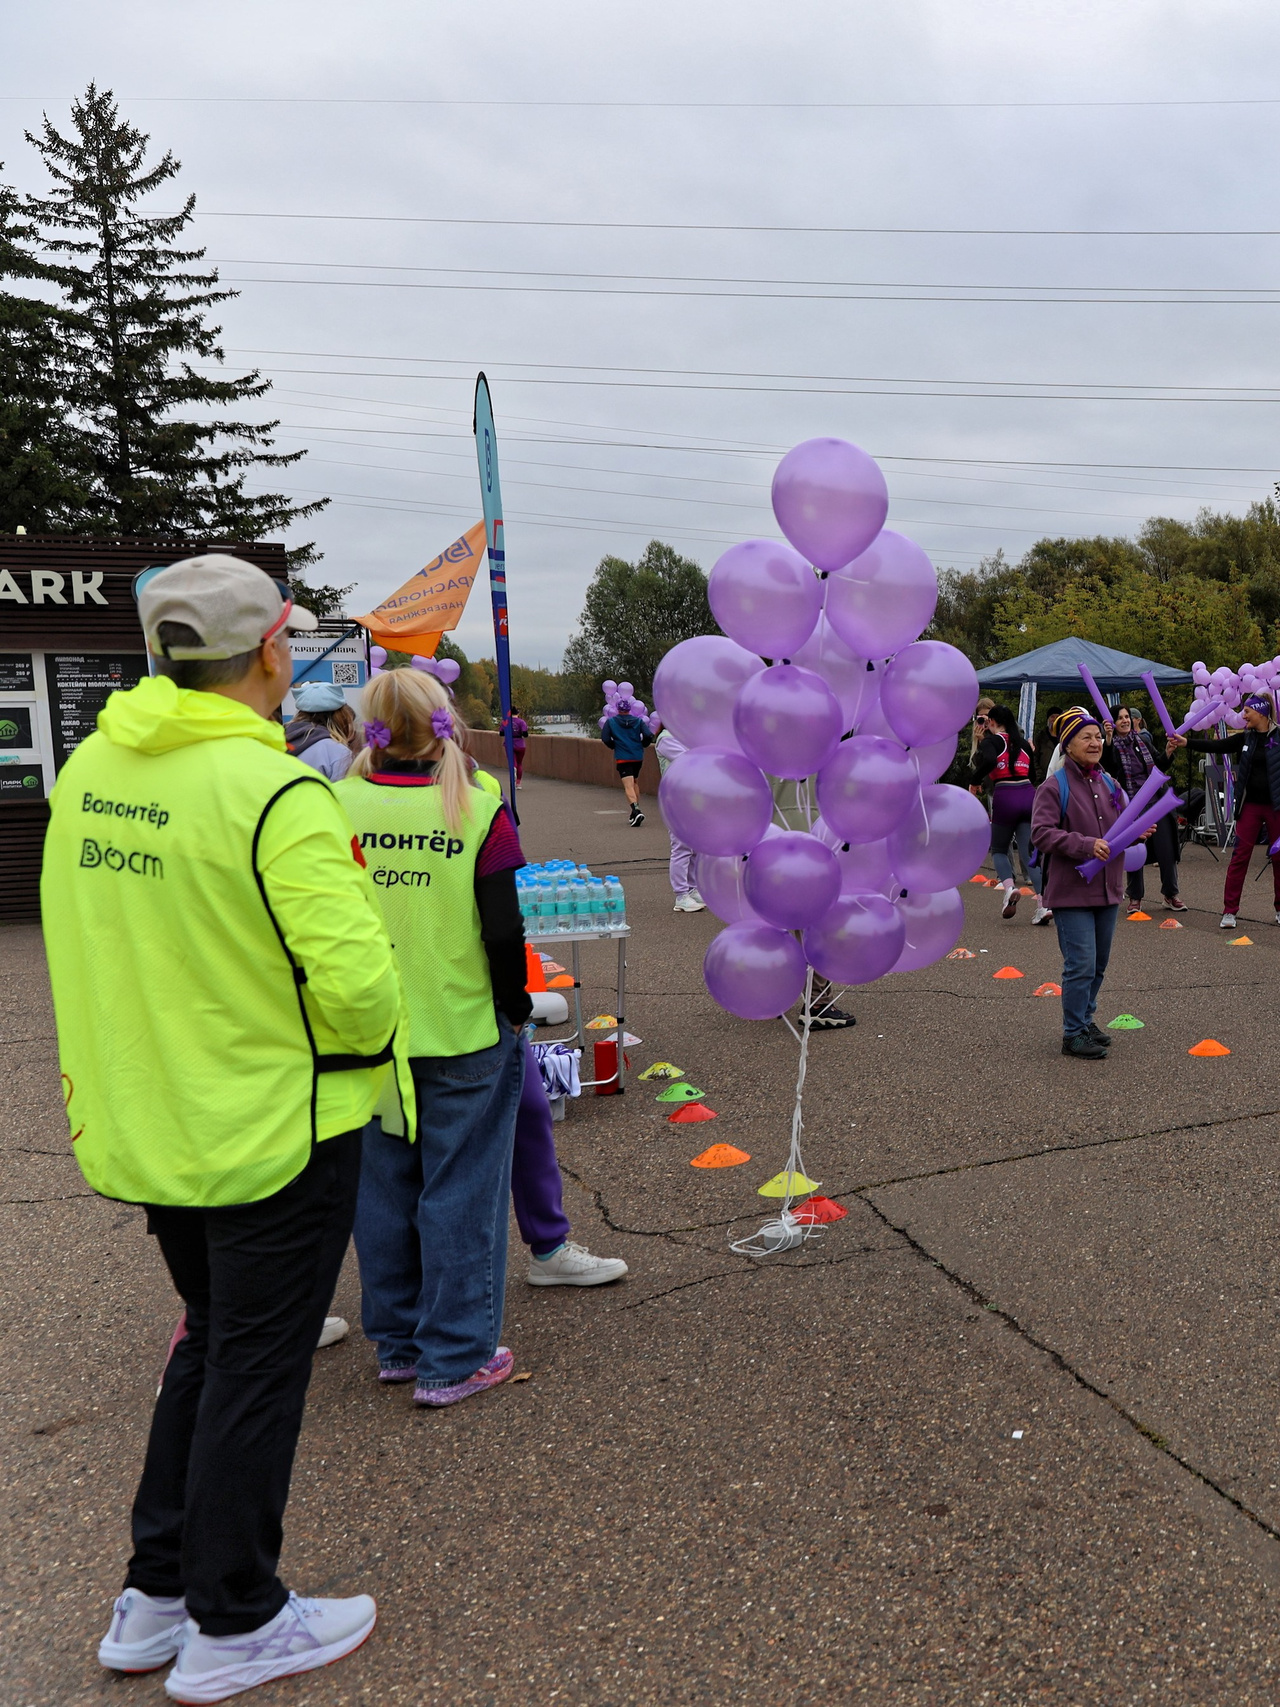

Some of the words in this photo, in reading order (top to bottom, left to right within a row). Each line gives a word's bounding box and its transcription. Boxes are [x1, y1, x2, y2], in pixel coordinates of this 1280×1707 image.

[0, 569, 109, 605] ARK
[359, 829, 464, 859] лонтёр
[372, 866, 431, 888] ёрст
